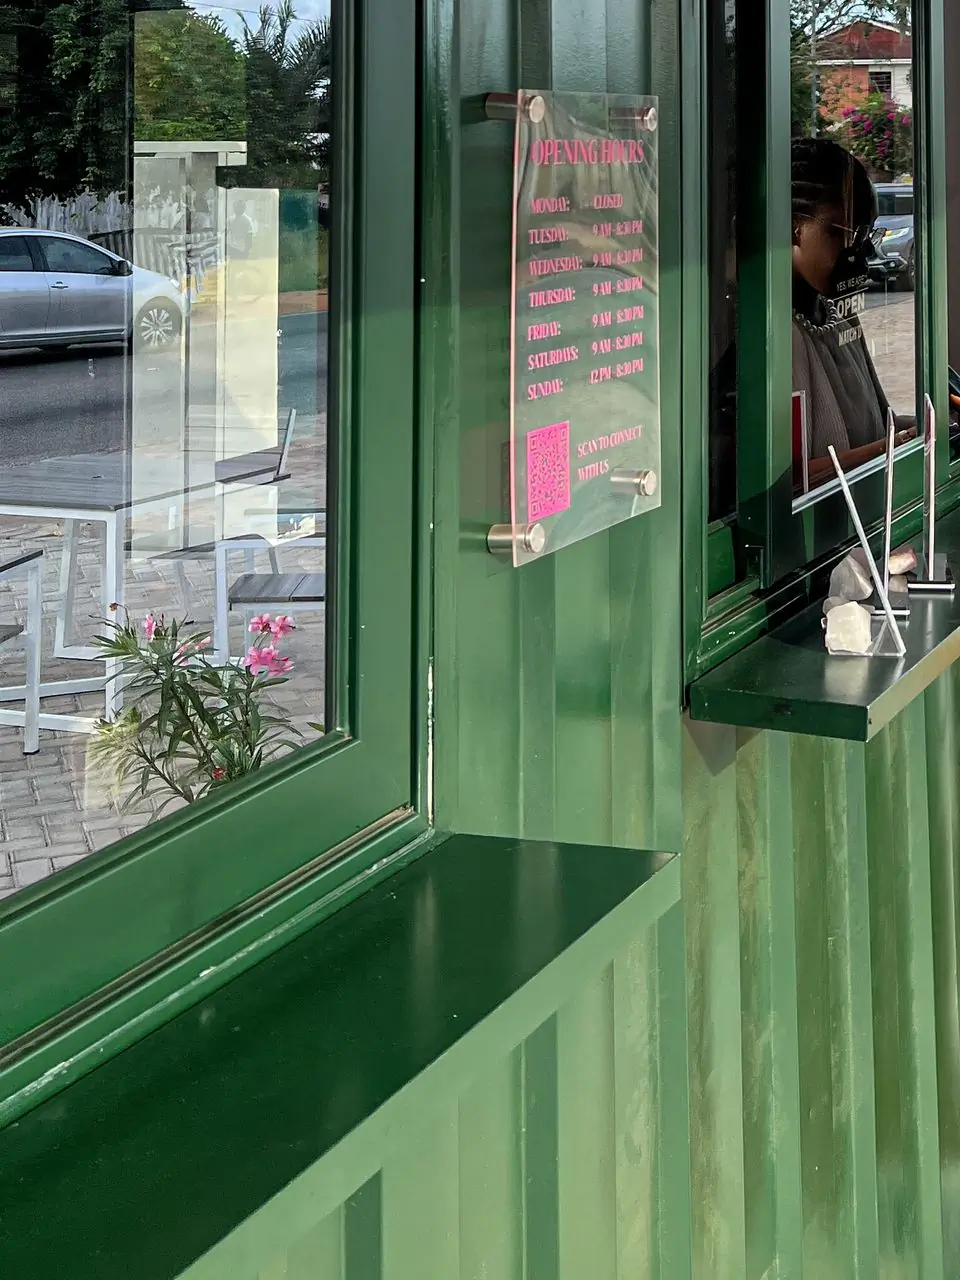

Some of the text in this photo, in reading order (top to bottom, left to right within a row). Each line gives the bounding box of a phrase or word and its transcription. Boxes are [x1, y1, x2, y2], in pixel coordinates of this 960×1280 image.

[531, 139, 645, 165] OPENING HOURS
[531, 193, 624, 213] MONDAY: CLOSED
[528, 225, 569, 244] TUESDAY:
[592, 224, 598, 236] 9
[600, 222, 612, 236] AM
[529, 255, 583, 276] WEDNESDAY:
[592, 254, 598, 267] 9
[600, 252, 612, 266] AM
[529, 286, 576, 308] THURSDAY:
[592, 283, 598, 296] 9
[600, 281, 612, 296] AM
[837, 292, 865, 319] OPEN
[528, 321, 561, 341] FRIDAY:
[592, 314, 598, 328] 9
[599, 311, 612, 327] AM
[528, 345, 579, 370] SATURDAYS:
[592, 341, 598, 355] 9
[599, 339, 611, 354] AM
[528, 378, 563, 401] SUNDAY:
[590, 369, 598, 384] 12
[600, 366, 612, 381] PM
[577, 425, 643, 458] SCAN TO CONNECT
[578, 459, 609, 480] WITH US
